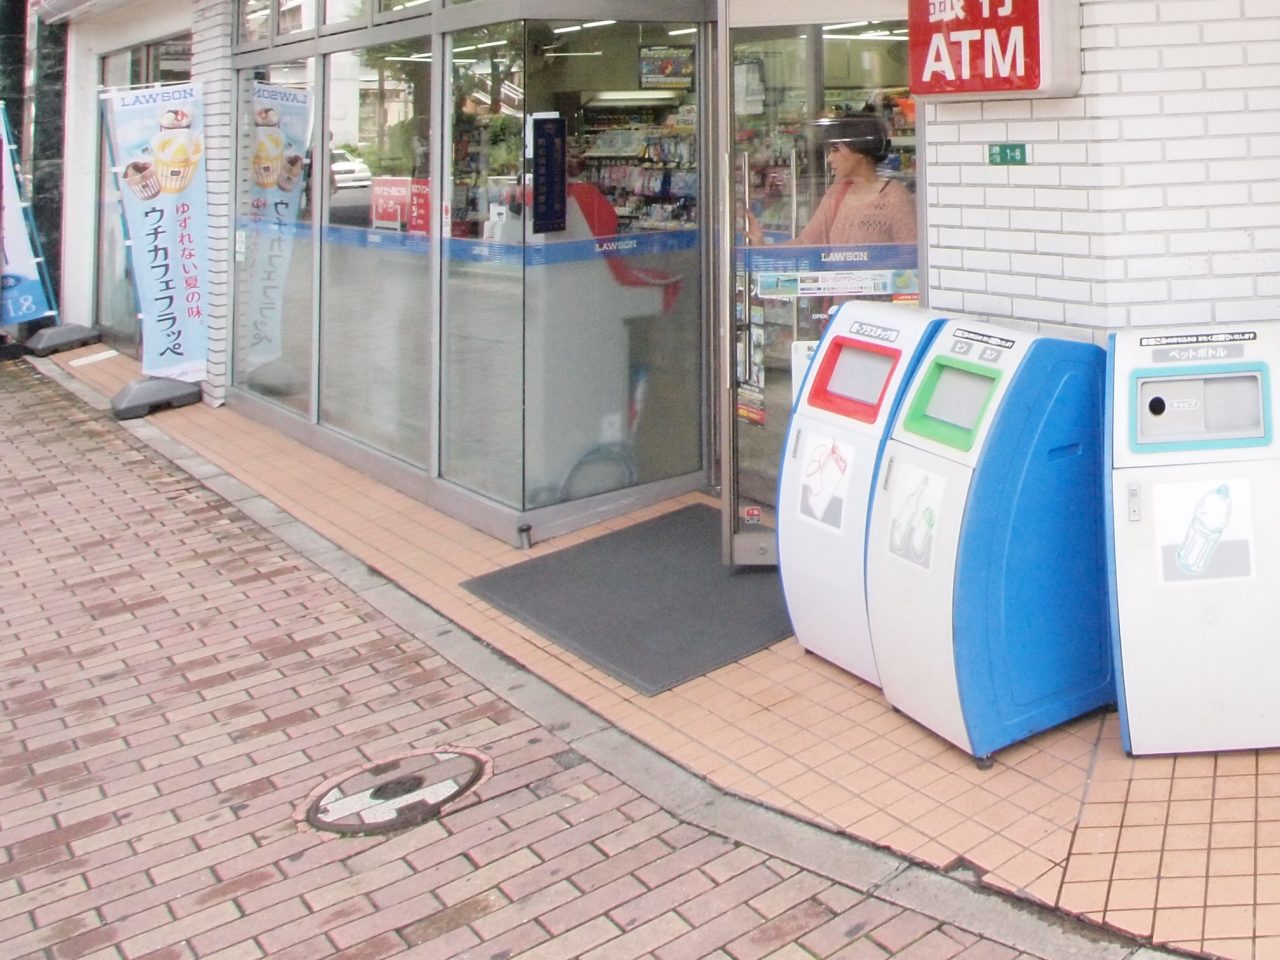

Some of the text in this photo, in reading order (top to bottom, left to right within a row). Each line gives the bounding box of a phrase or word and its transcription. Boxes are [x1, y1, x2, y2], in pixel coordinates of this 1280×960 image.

[922, 26, 1024, 82] ATM
[121, 88, 195, 108] LAWSON
[821, 252, 868, 261] LAWSON
[144, 206, 184, 357] ウチカフェフラッペ
[1169, 347, 1227, 359] ペットボトル
